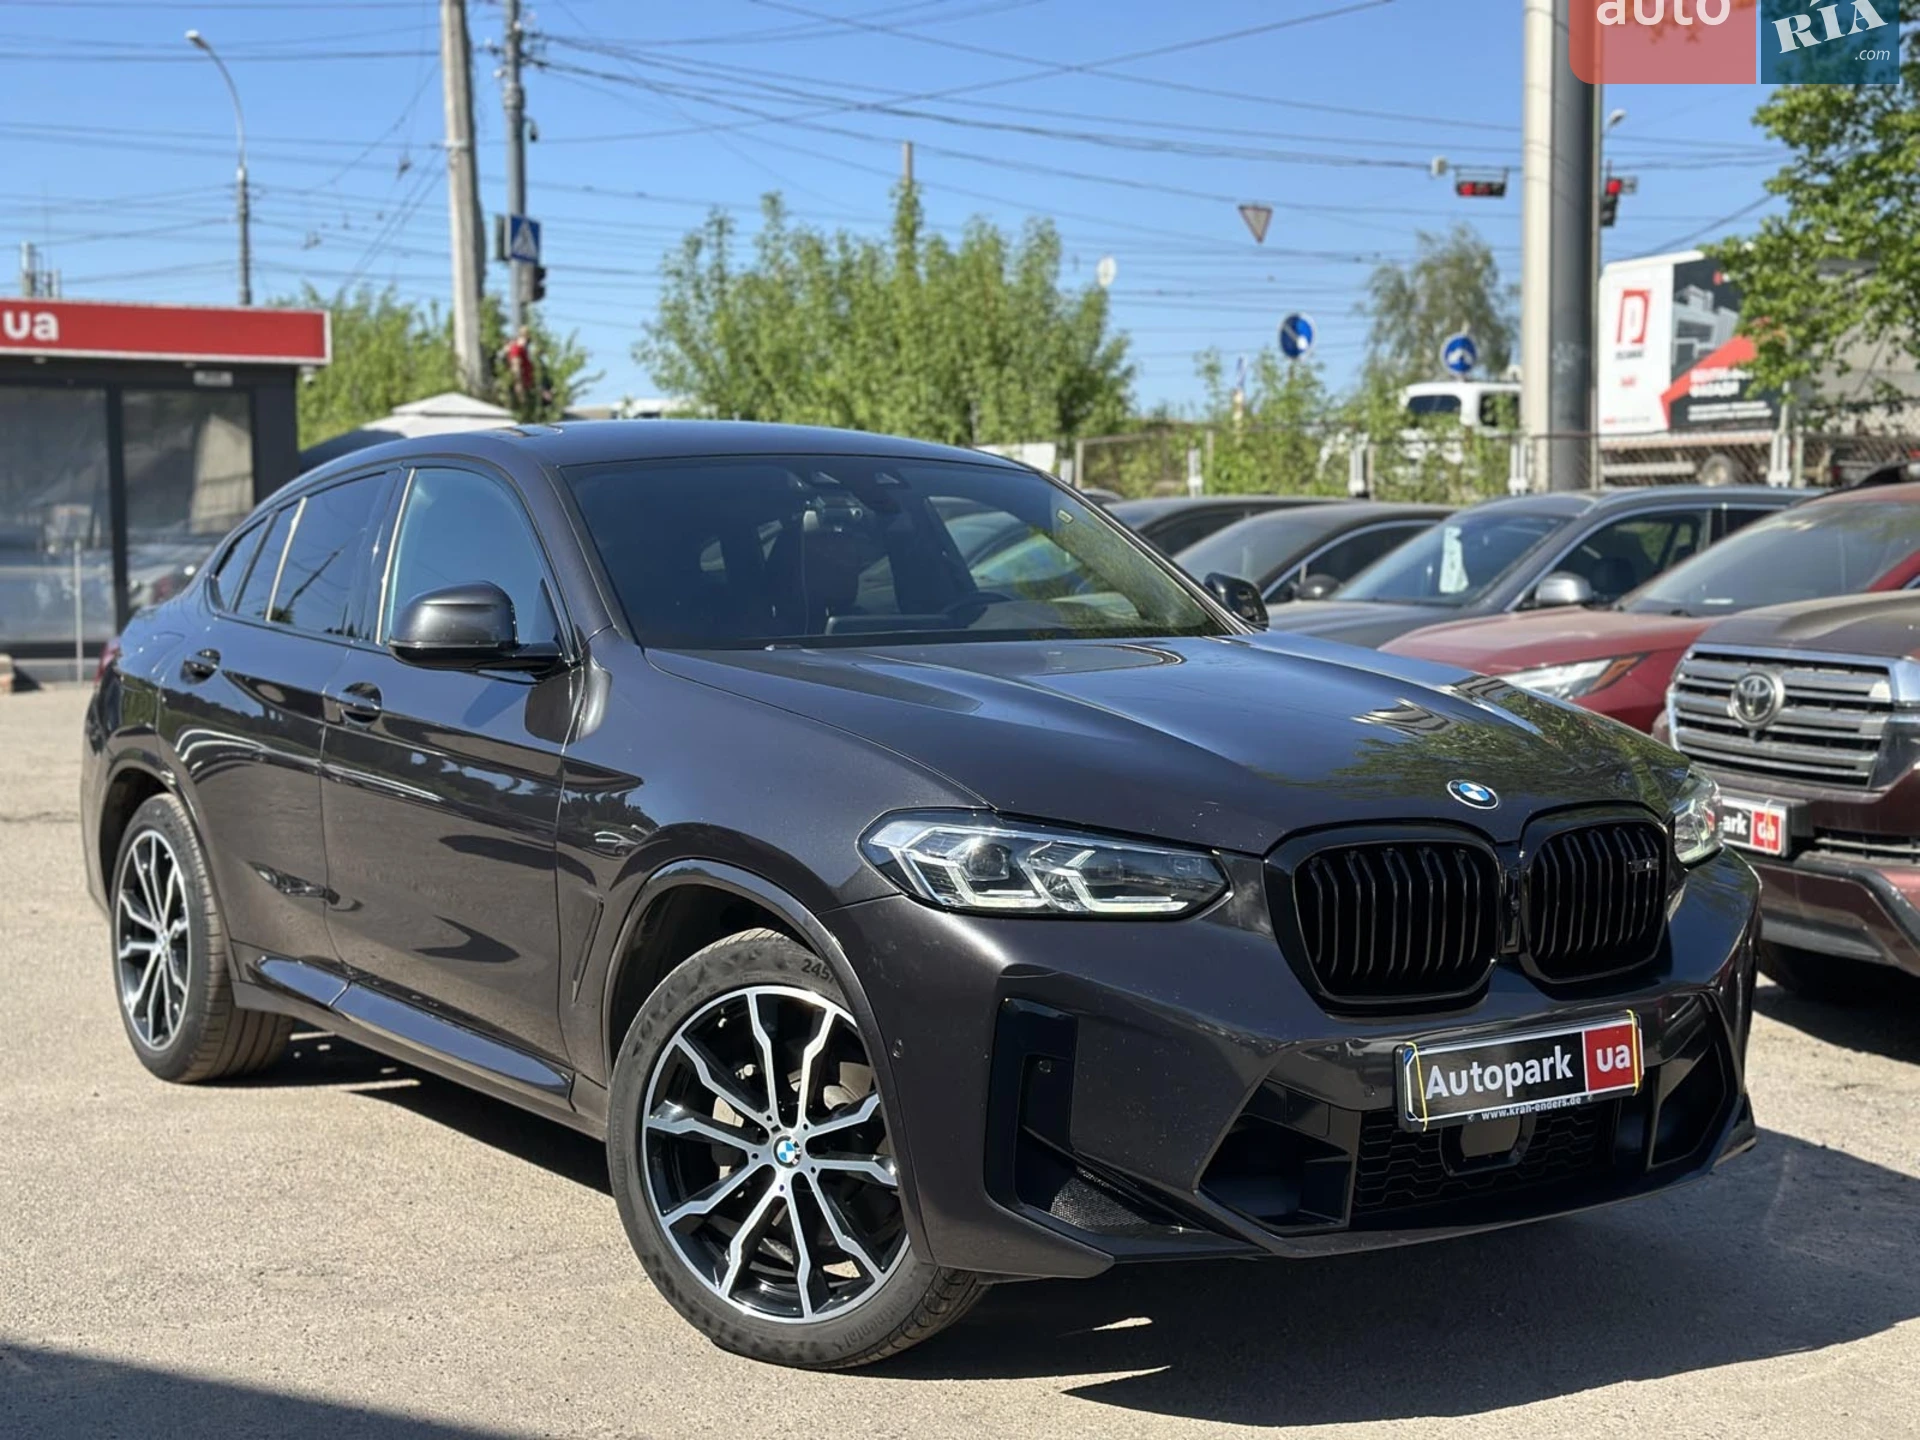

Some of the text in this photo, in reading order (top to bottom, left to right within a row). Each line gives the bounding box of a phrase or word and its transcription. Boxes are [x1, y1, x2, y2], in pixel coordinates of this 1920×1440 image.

[3, 310, 59, 341] ua
[1425, 1043, 1631, 1100] Autopark ua
